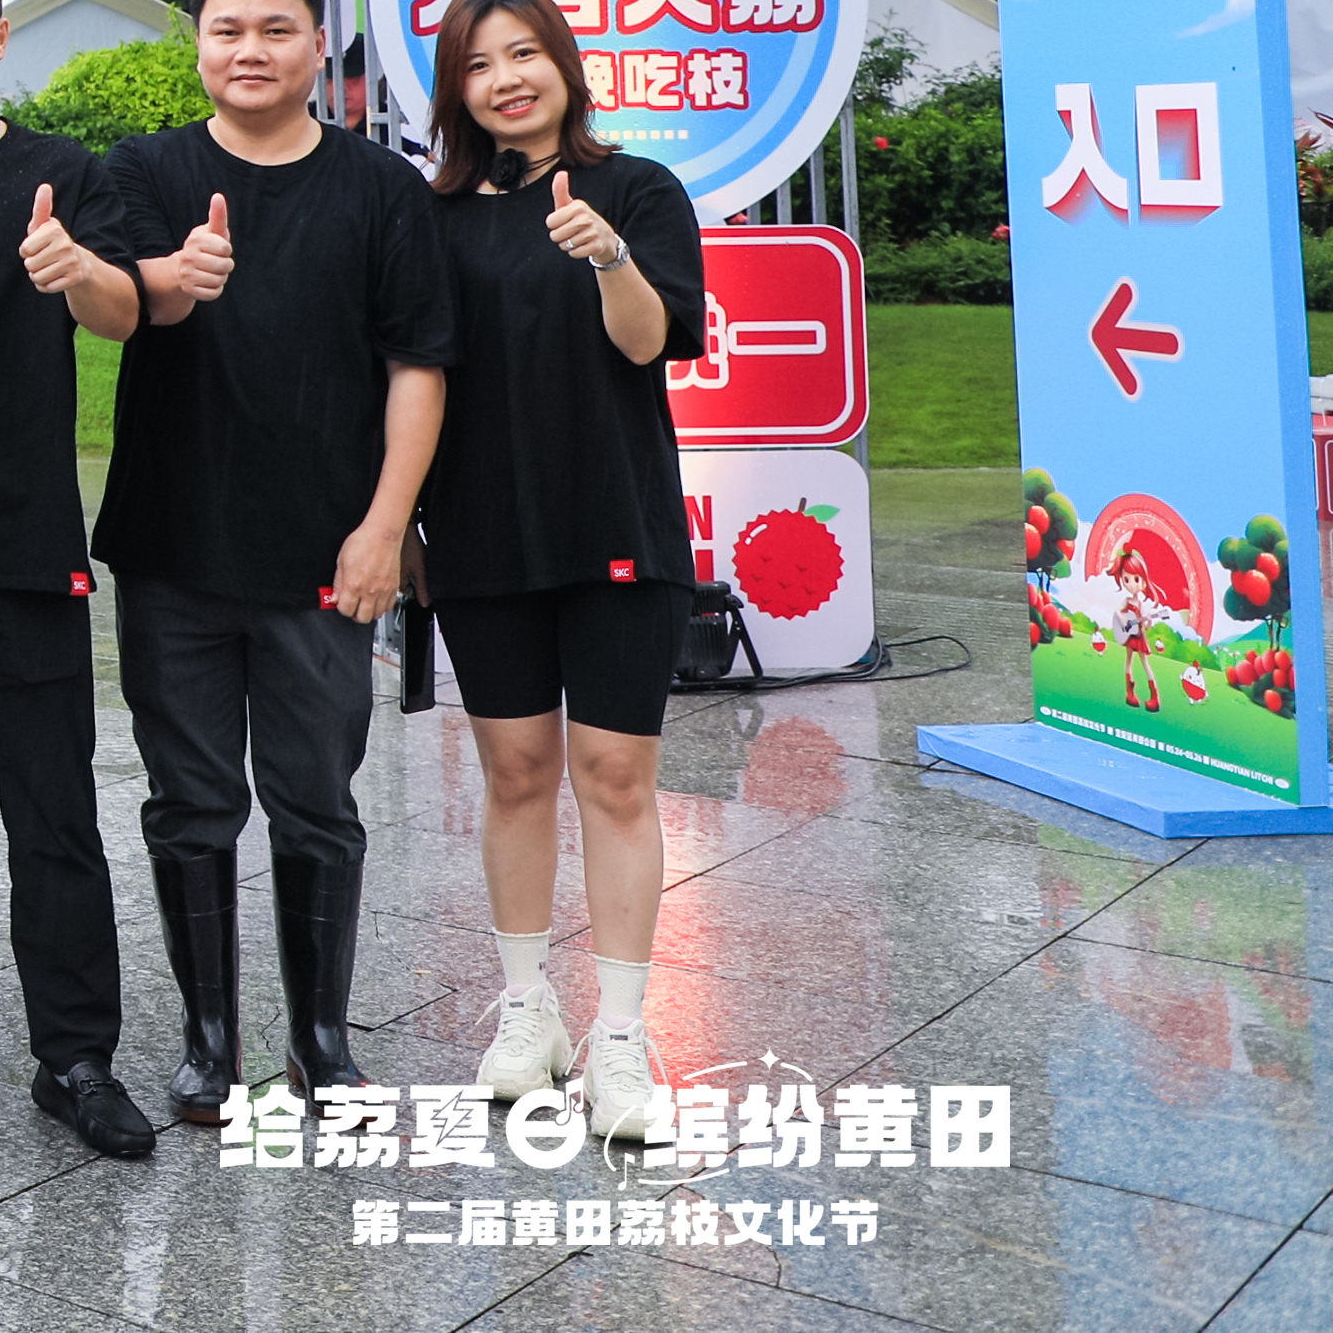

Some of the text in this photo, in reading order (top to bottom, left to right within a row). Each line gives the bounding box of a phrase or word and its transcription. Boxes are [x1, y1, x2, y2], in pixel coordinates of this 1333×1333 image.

[1041, 82, 1223, 210] 入口
[613, 568, 630, 578] SKC
[1210, 757, 1251, 778] HUANGTIAN
[1251, 770, 1274, 786] LITCHI
